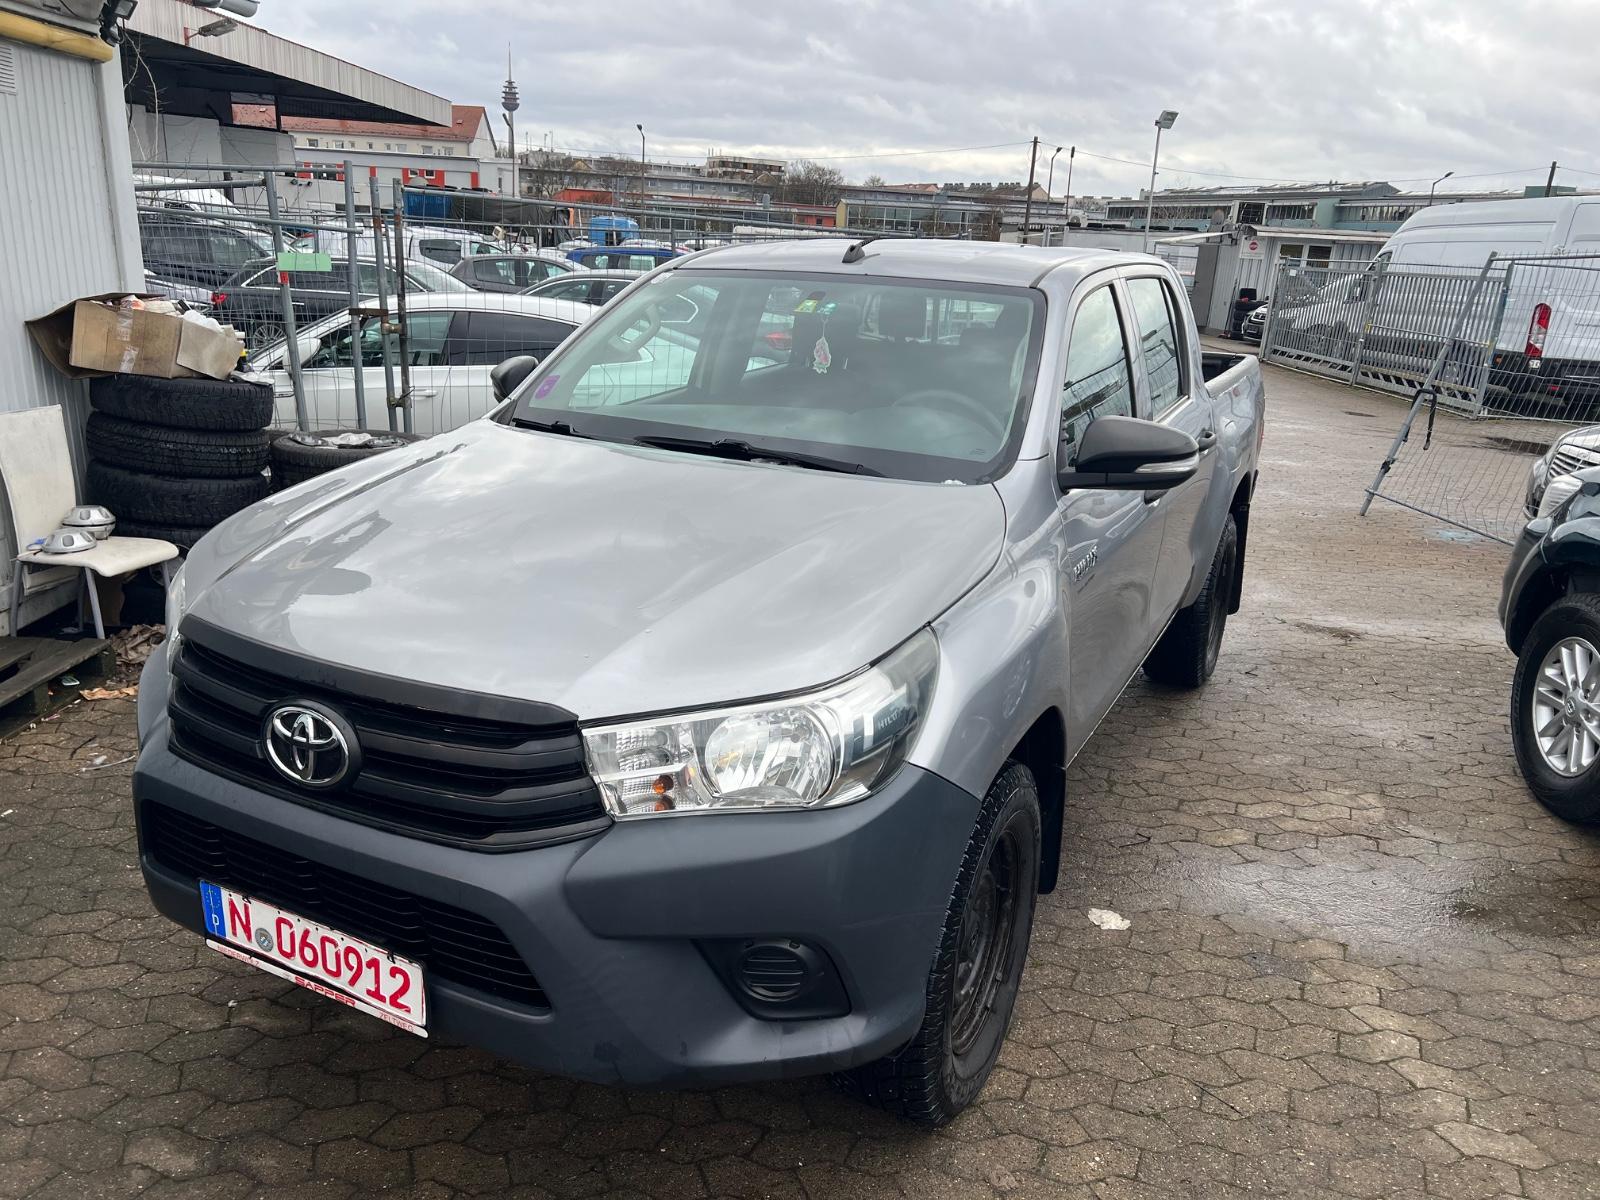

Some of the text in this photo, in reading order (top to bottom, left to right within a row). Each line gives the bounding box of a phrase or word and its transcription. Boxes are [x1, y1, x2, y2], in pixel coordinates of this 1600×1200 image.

[212, 913, 219, 925] D
[228, 897, 412, 1013] N 060912
[295, 975, 356, 1007] SAPPER
